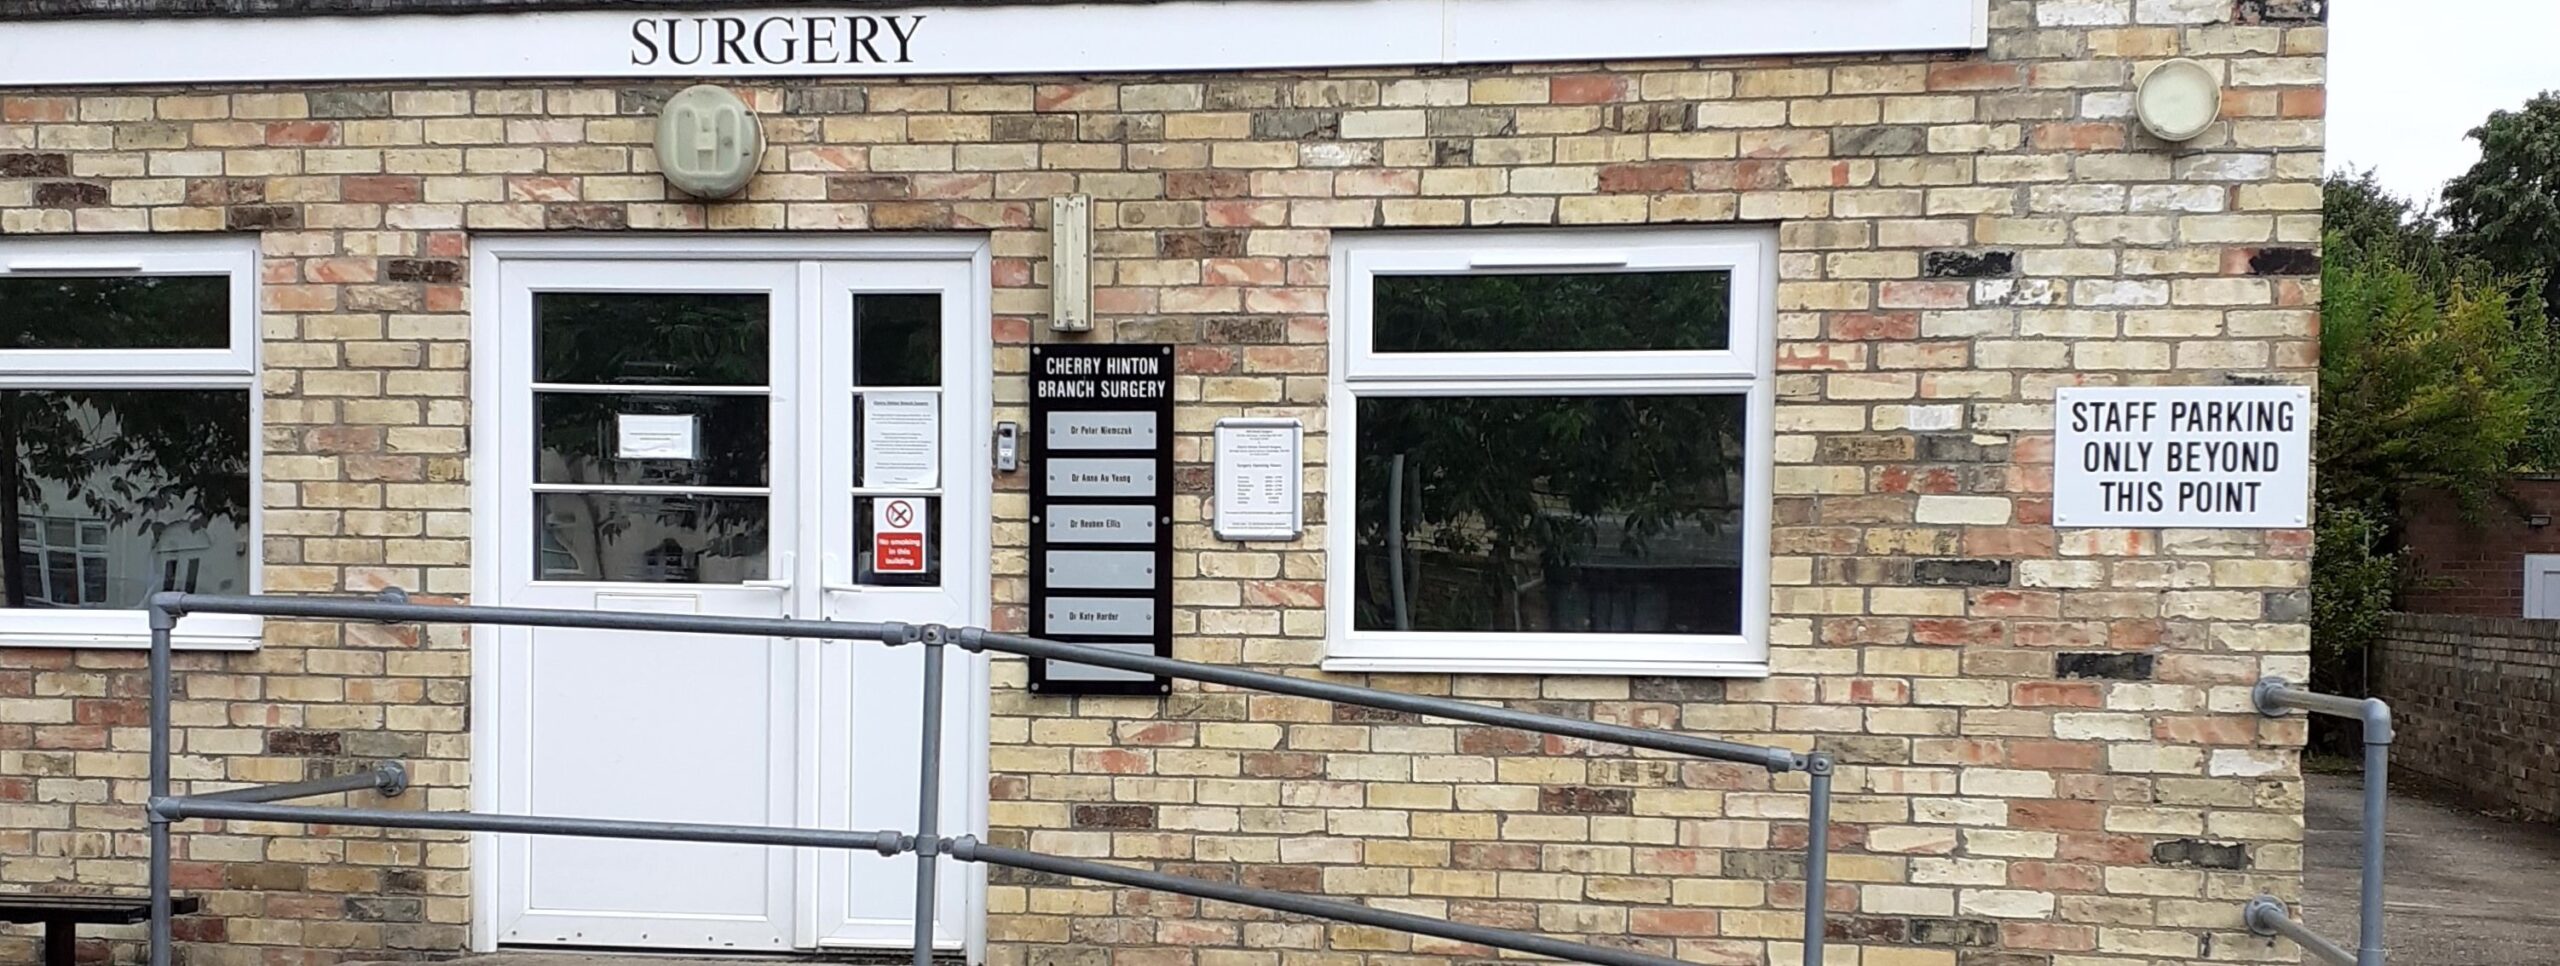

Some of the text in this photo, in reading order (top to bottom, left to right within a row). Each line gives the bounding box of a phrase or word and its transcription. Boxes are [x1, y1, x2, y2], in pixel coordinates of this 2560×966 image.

[631, 15, 927, 65] SURGERY
[1046, 357, 1159, 375] CHERRY HINTON
[1038, 380, 1166, 398] BRANCH SURGERY
[2072, 401, 2294, 432] STAFF PARKING
[1070, 425, 1078, 435] Dr
[2083, 441, 2279, 472] ONLY BEYOND
[1071, 473, 1079, 482] Dr
[2099, 481, 2261, 512] THIS POINT
[1069, 519, 1078, 528] Dr
[890, 538, 921, 547] smoking
[885, 557, 914, 566] building
[1069, 611, 1076, 620] Dr
